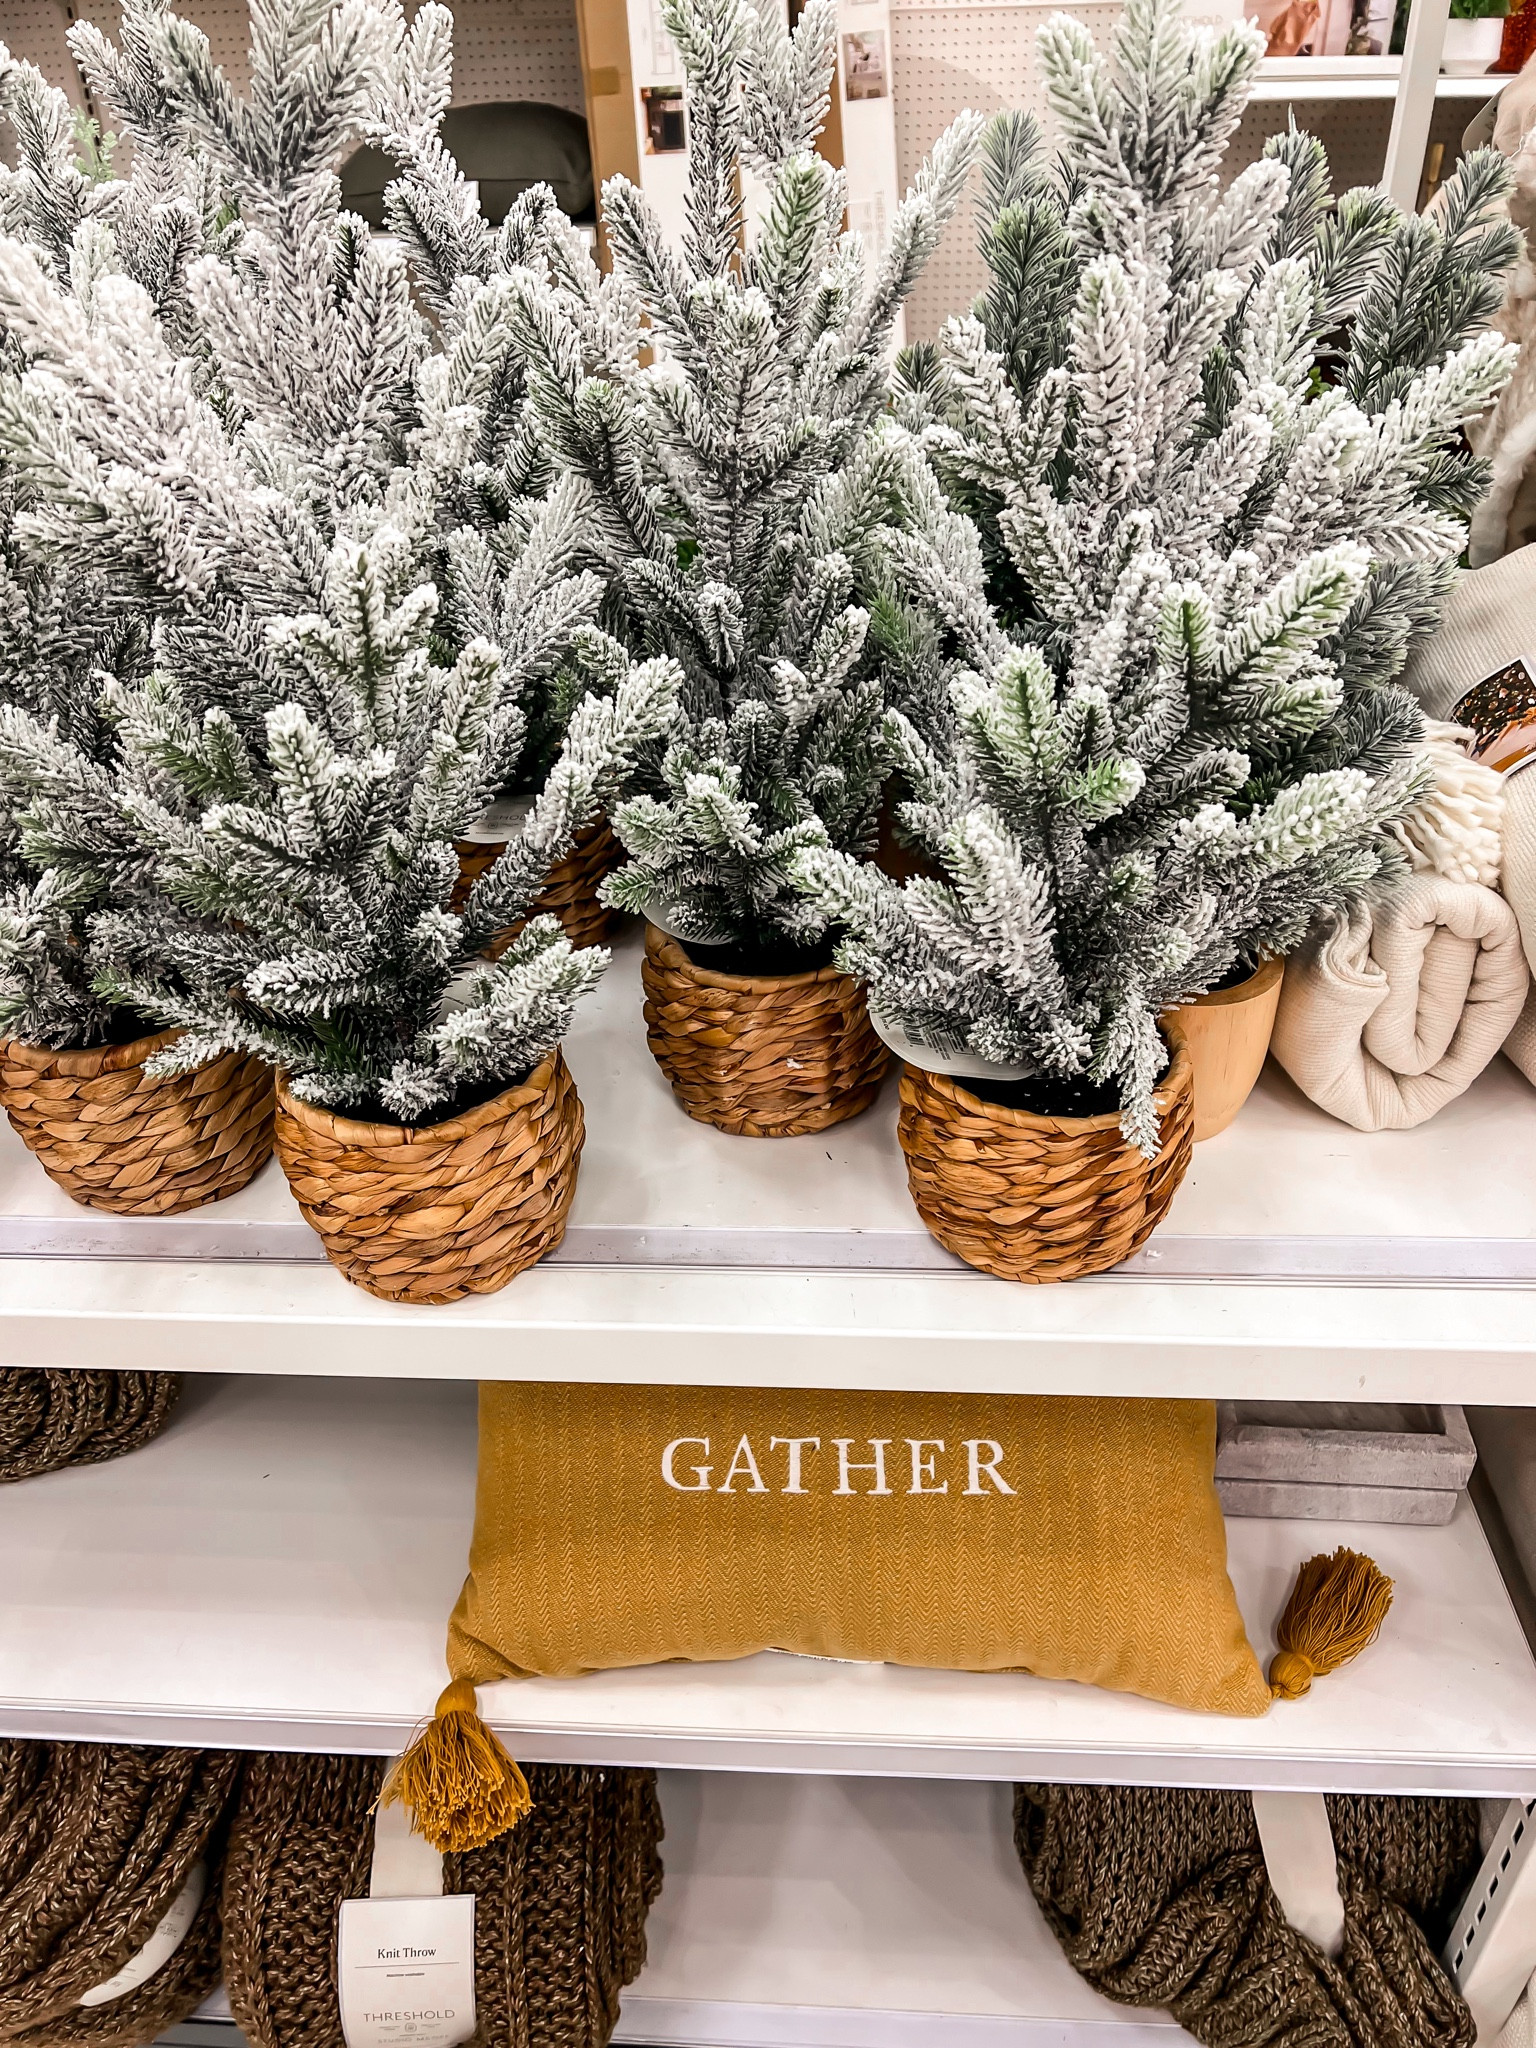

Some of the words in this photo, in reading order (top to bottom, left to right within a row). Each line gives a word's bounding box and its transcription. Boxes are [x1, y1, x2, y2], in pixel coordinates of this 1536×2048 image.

[661, 1433, 1018, 1496] GATHER
[377, 1948, 400, 1959] Knit
[402, 1947, 437, 1958] Throw
[363, 2009, 455, 2022] THRESHOLD
